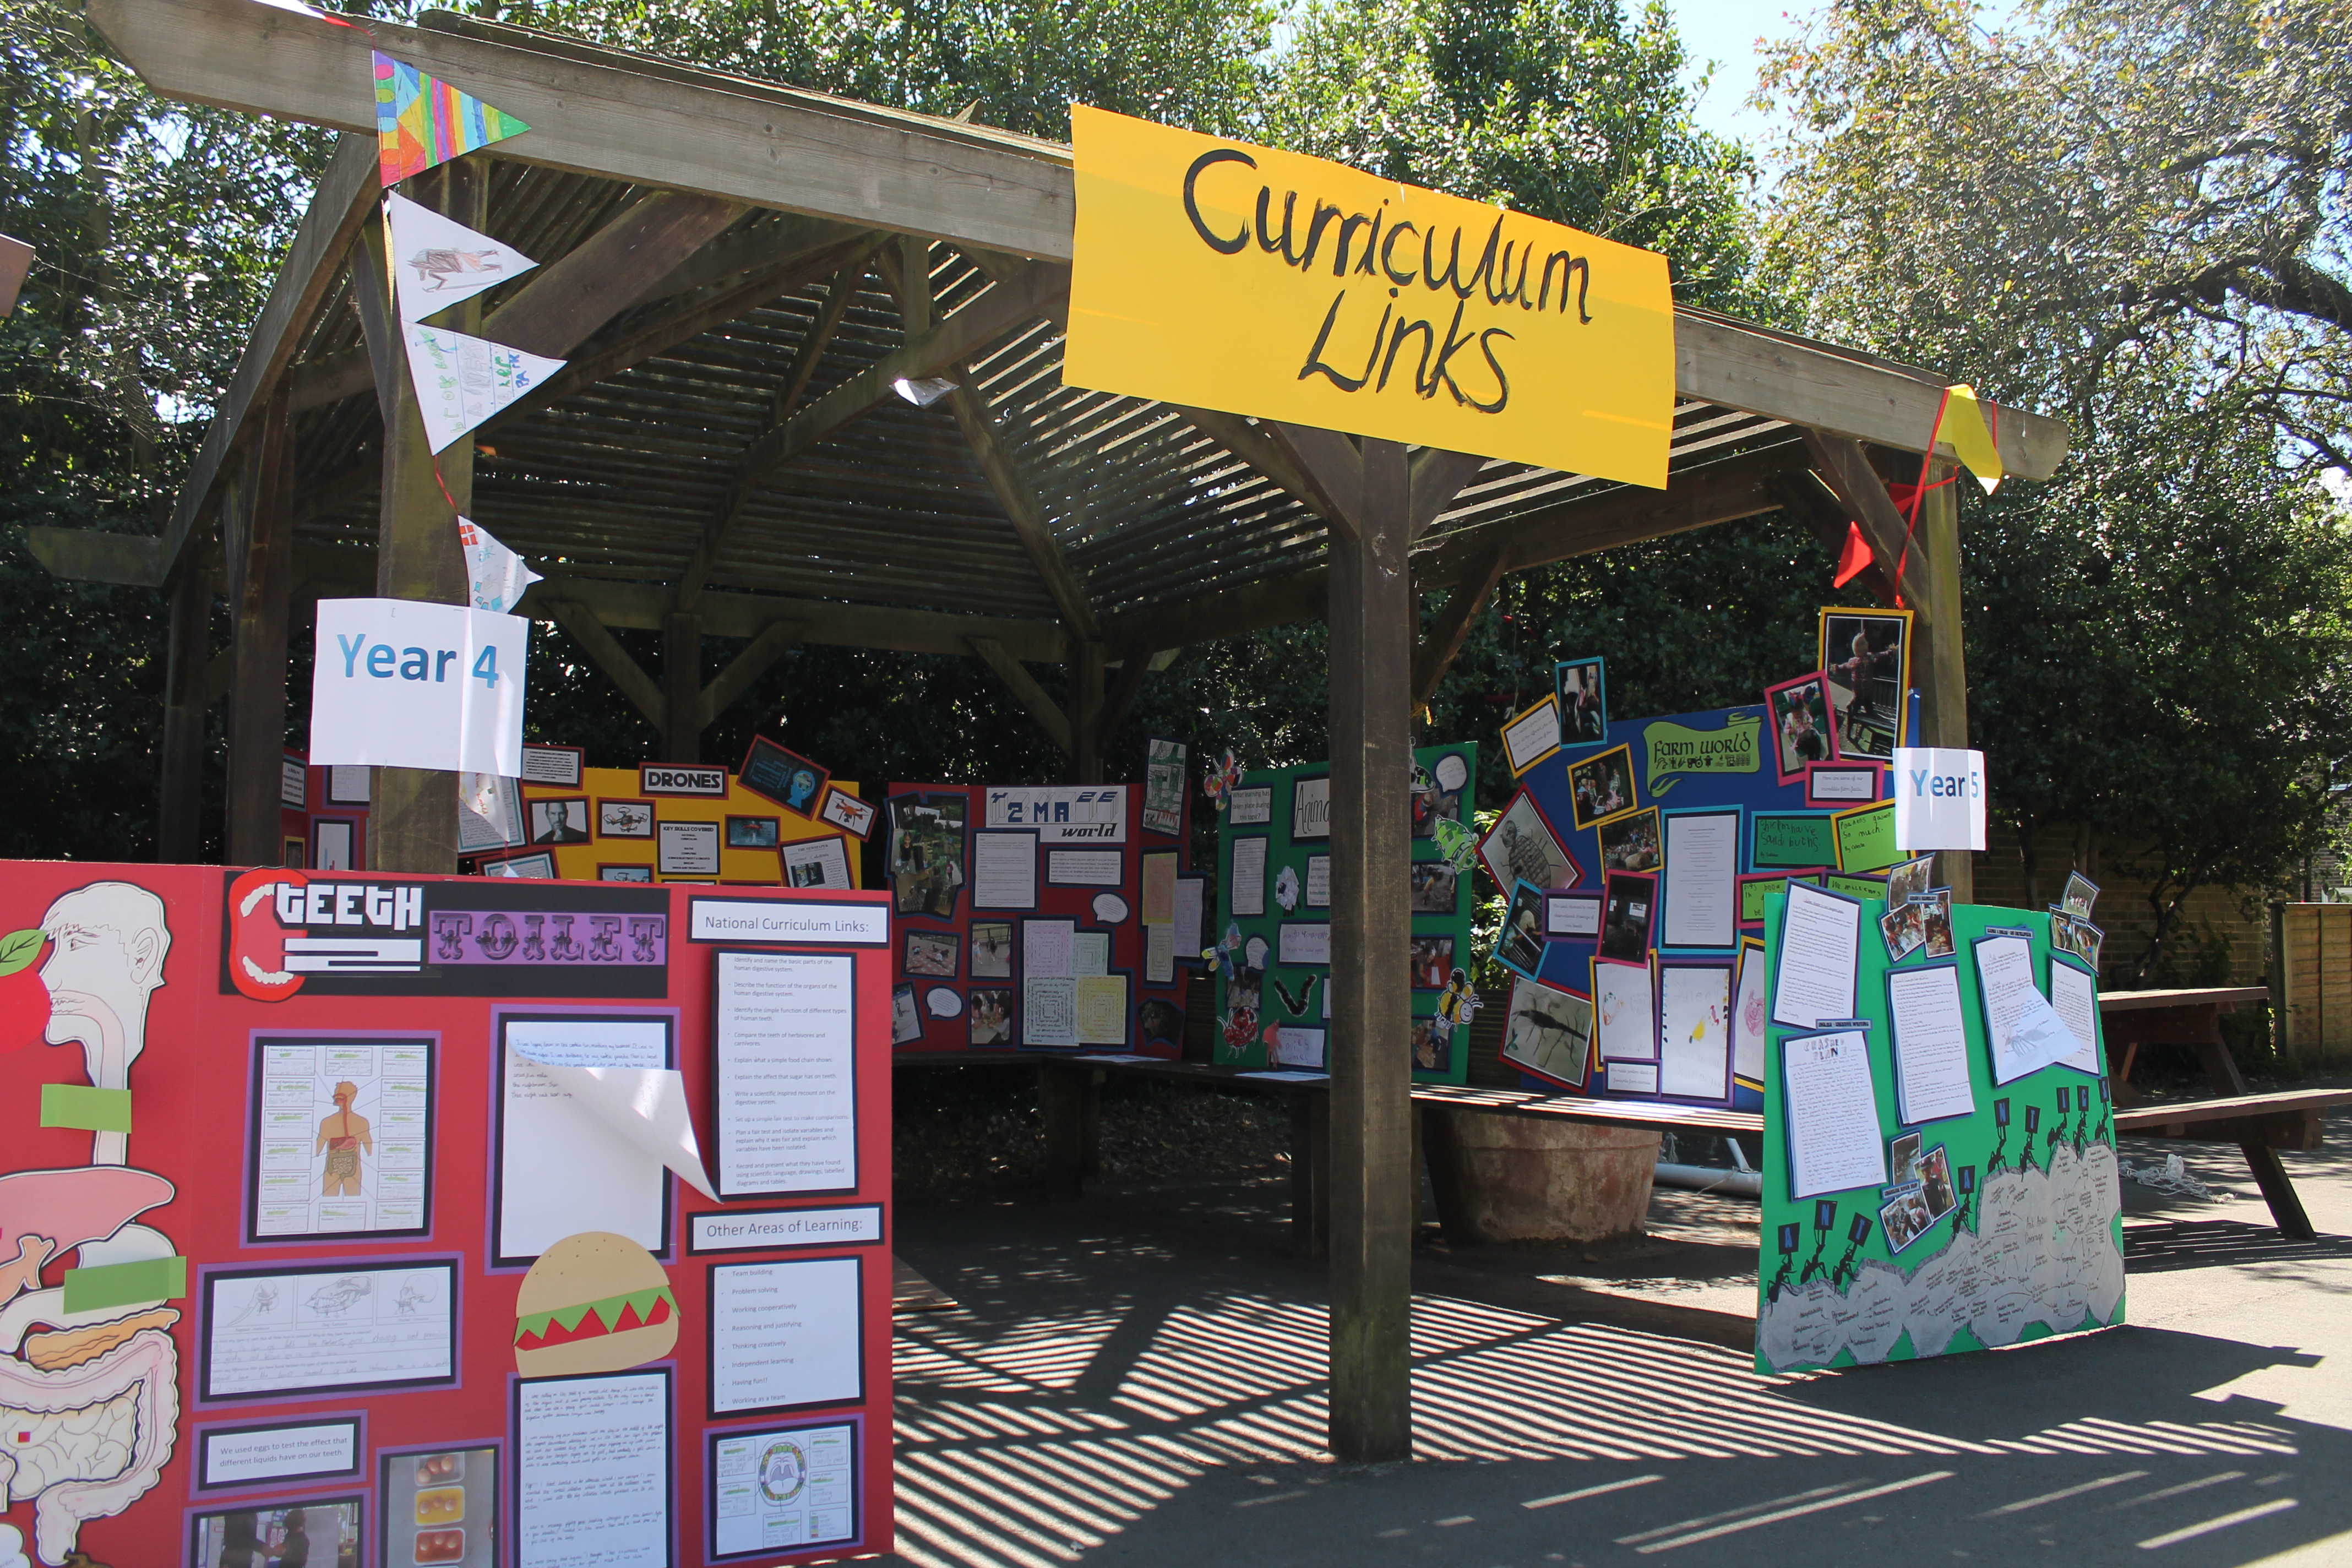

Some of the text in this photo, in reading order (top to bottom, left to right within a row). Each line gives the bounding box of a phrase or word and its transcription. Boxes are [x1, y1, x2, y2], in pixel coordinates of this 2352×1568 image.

[1183, 149, 1592, 324] Curriculum
[1297, 288, 1515, 413] Links
[337, 634, 499, 688] Year 4
[648, 772, 720, 788] DRONES
[1908, 769, 1978, 798] Year 5
[1061, 824, 1118, 837] world
[705, 916, 869, 933] National Curriculum Links:
[433, 913, 665, 963] TOILET
[706, 1218, 862, 1238] Other Areas of Learning:
[758, 1304, 797, 1312] cooperatively
[254, 1456, 277, 1464] liquids
